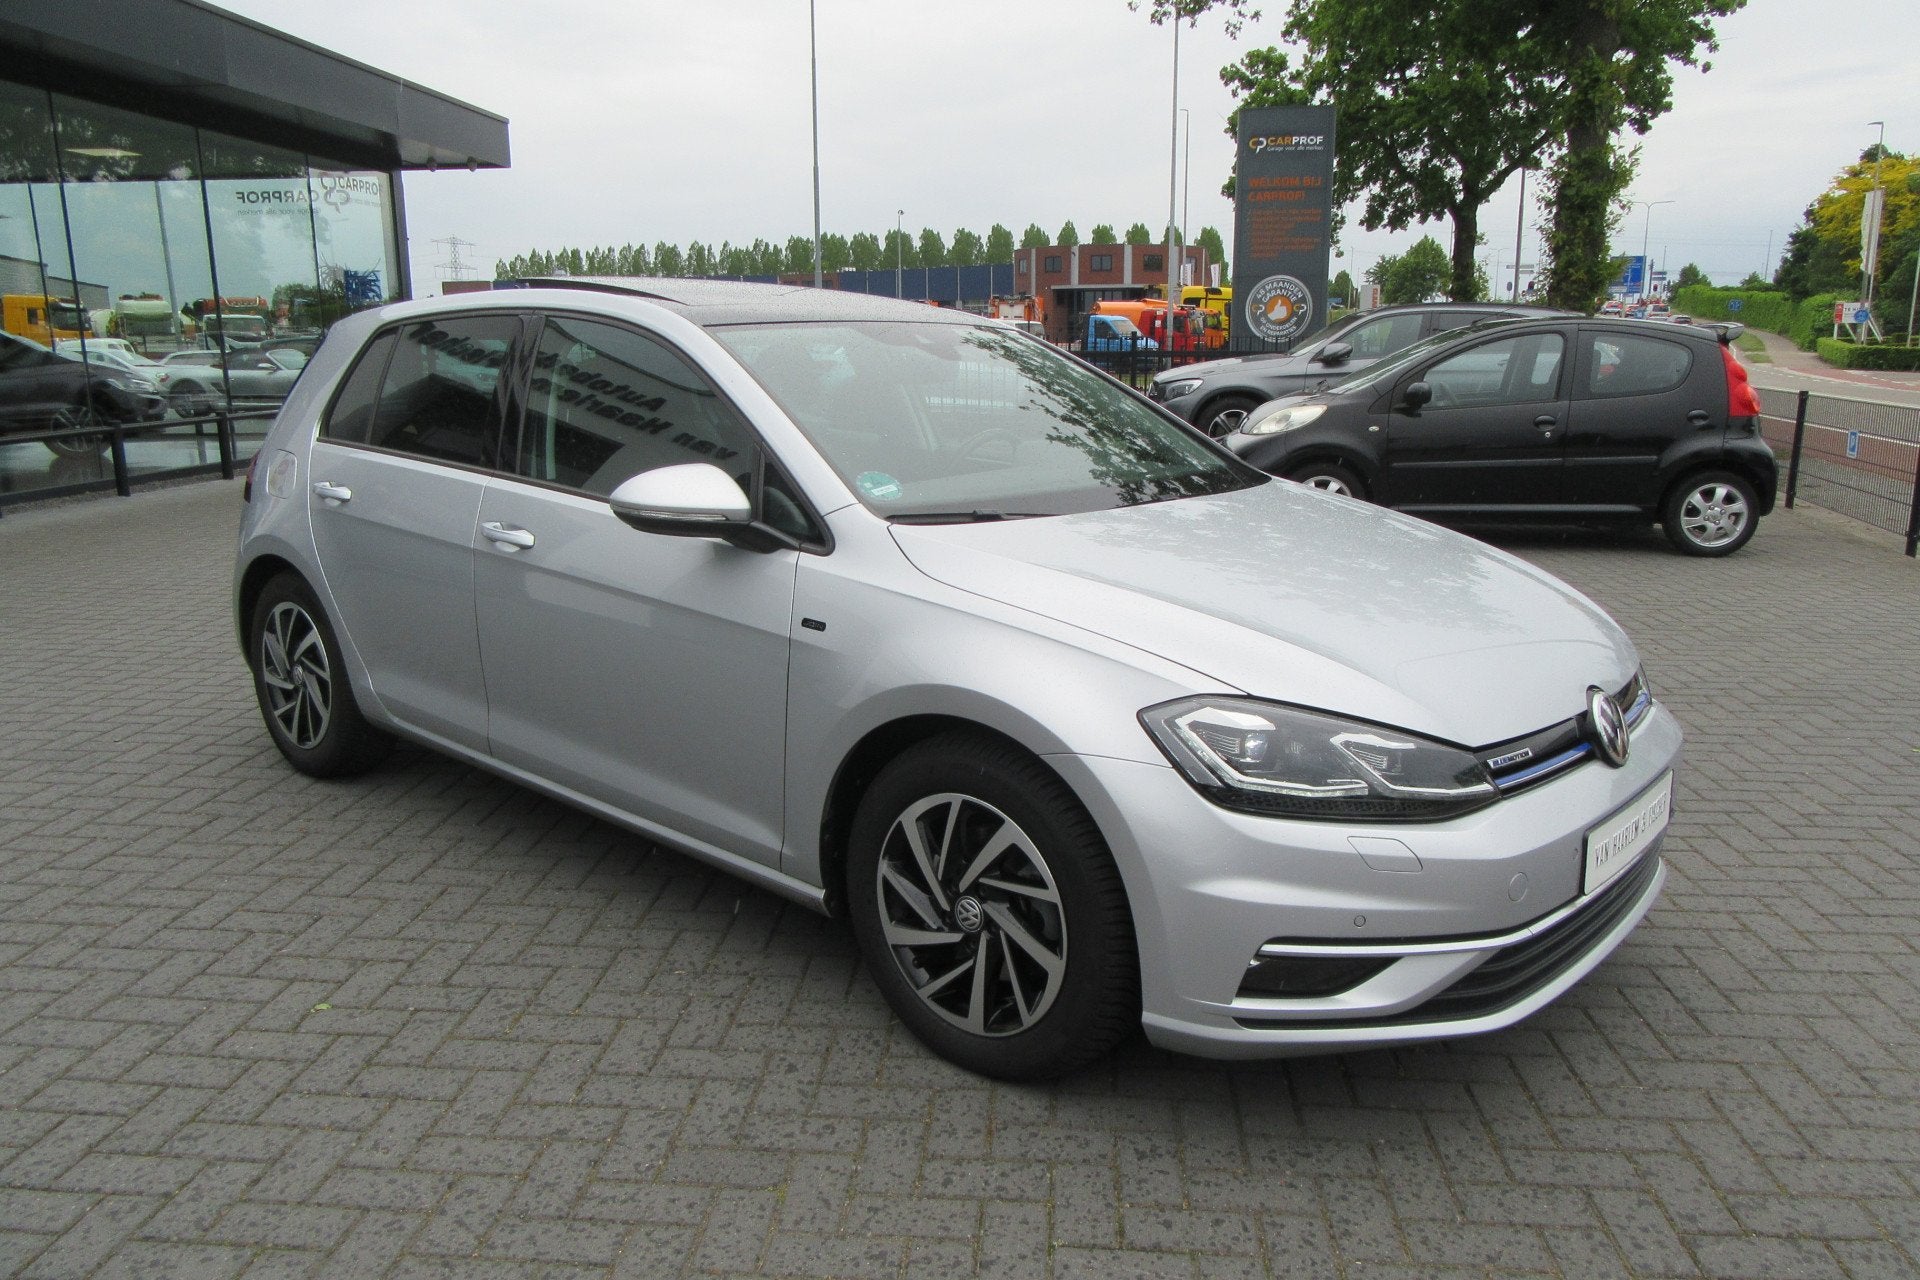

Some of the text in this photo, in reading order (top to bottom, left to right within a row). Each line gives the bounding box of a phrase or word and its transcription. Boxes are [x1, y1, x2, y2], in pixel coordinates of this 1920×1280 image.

[1268, 136, 1323, 145] CARPROF
[1263, 290, 1297, 302] GARANTIE
[1265, 282, 1303, 298] MAANDEN
